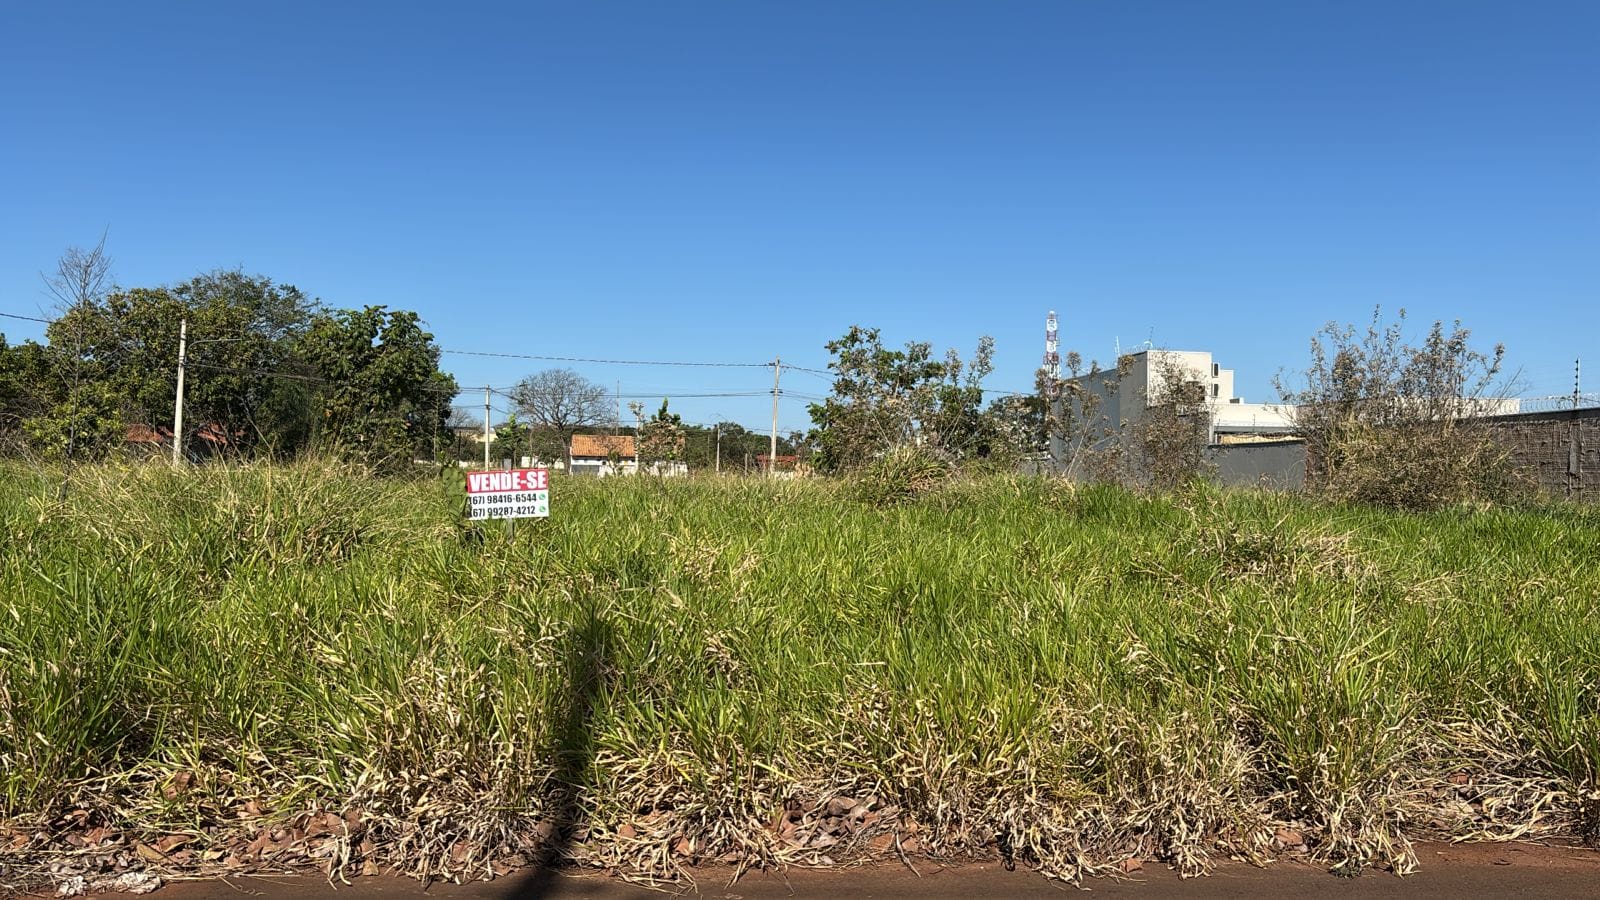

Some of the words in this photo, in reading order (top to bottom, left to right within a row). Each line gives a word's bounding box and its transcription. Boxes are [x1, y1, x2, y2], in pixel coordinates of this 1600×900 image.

[469, 471, 547, 492] VENDE-SE
[487, 493, 537, 504] 98416-6544
[487, 506, 536, 516] 99287-4212
